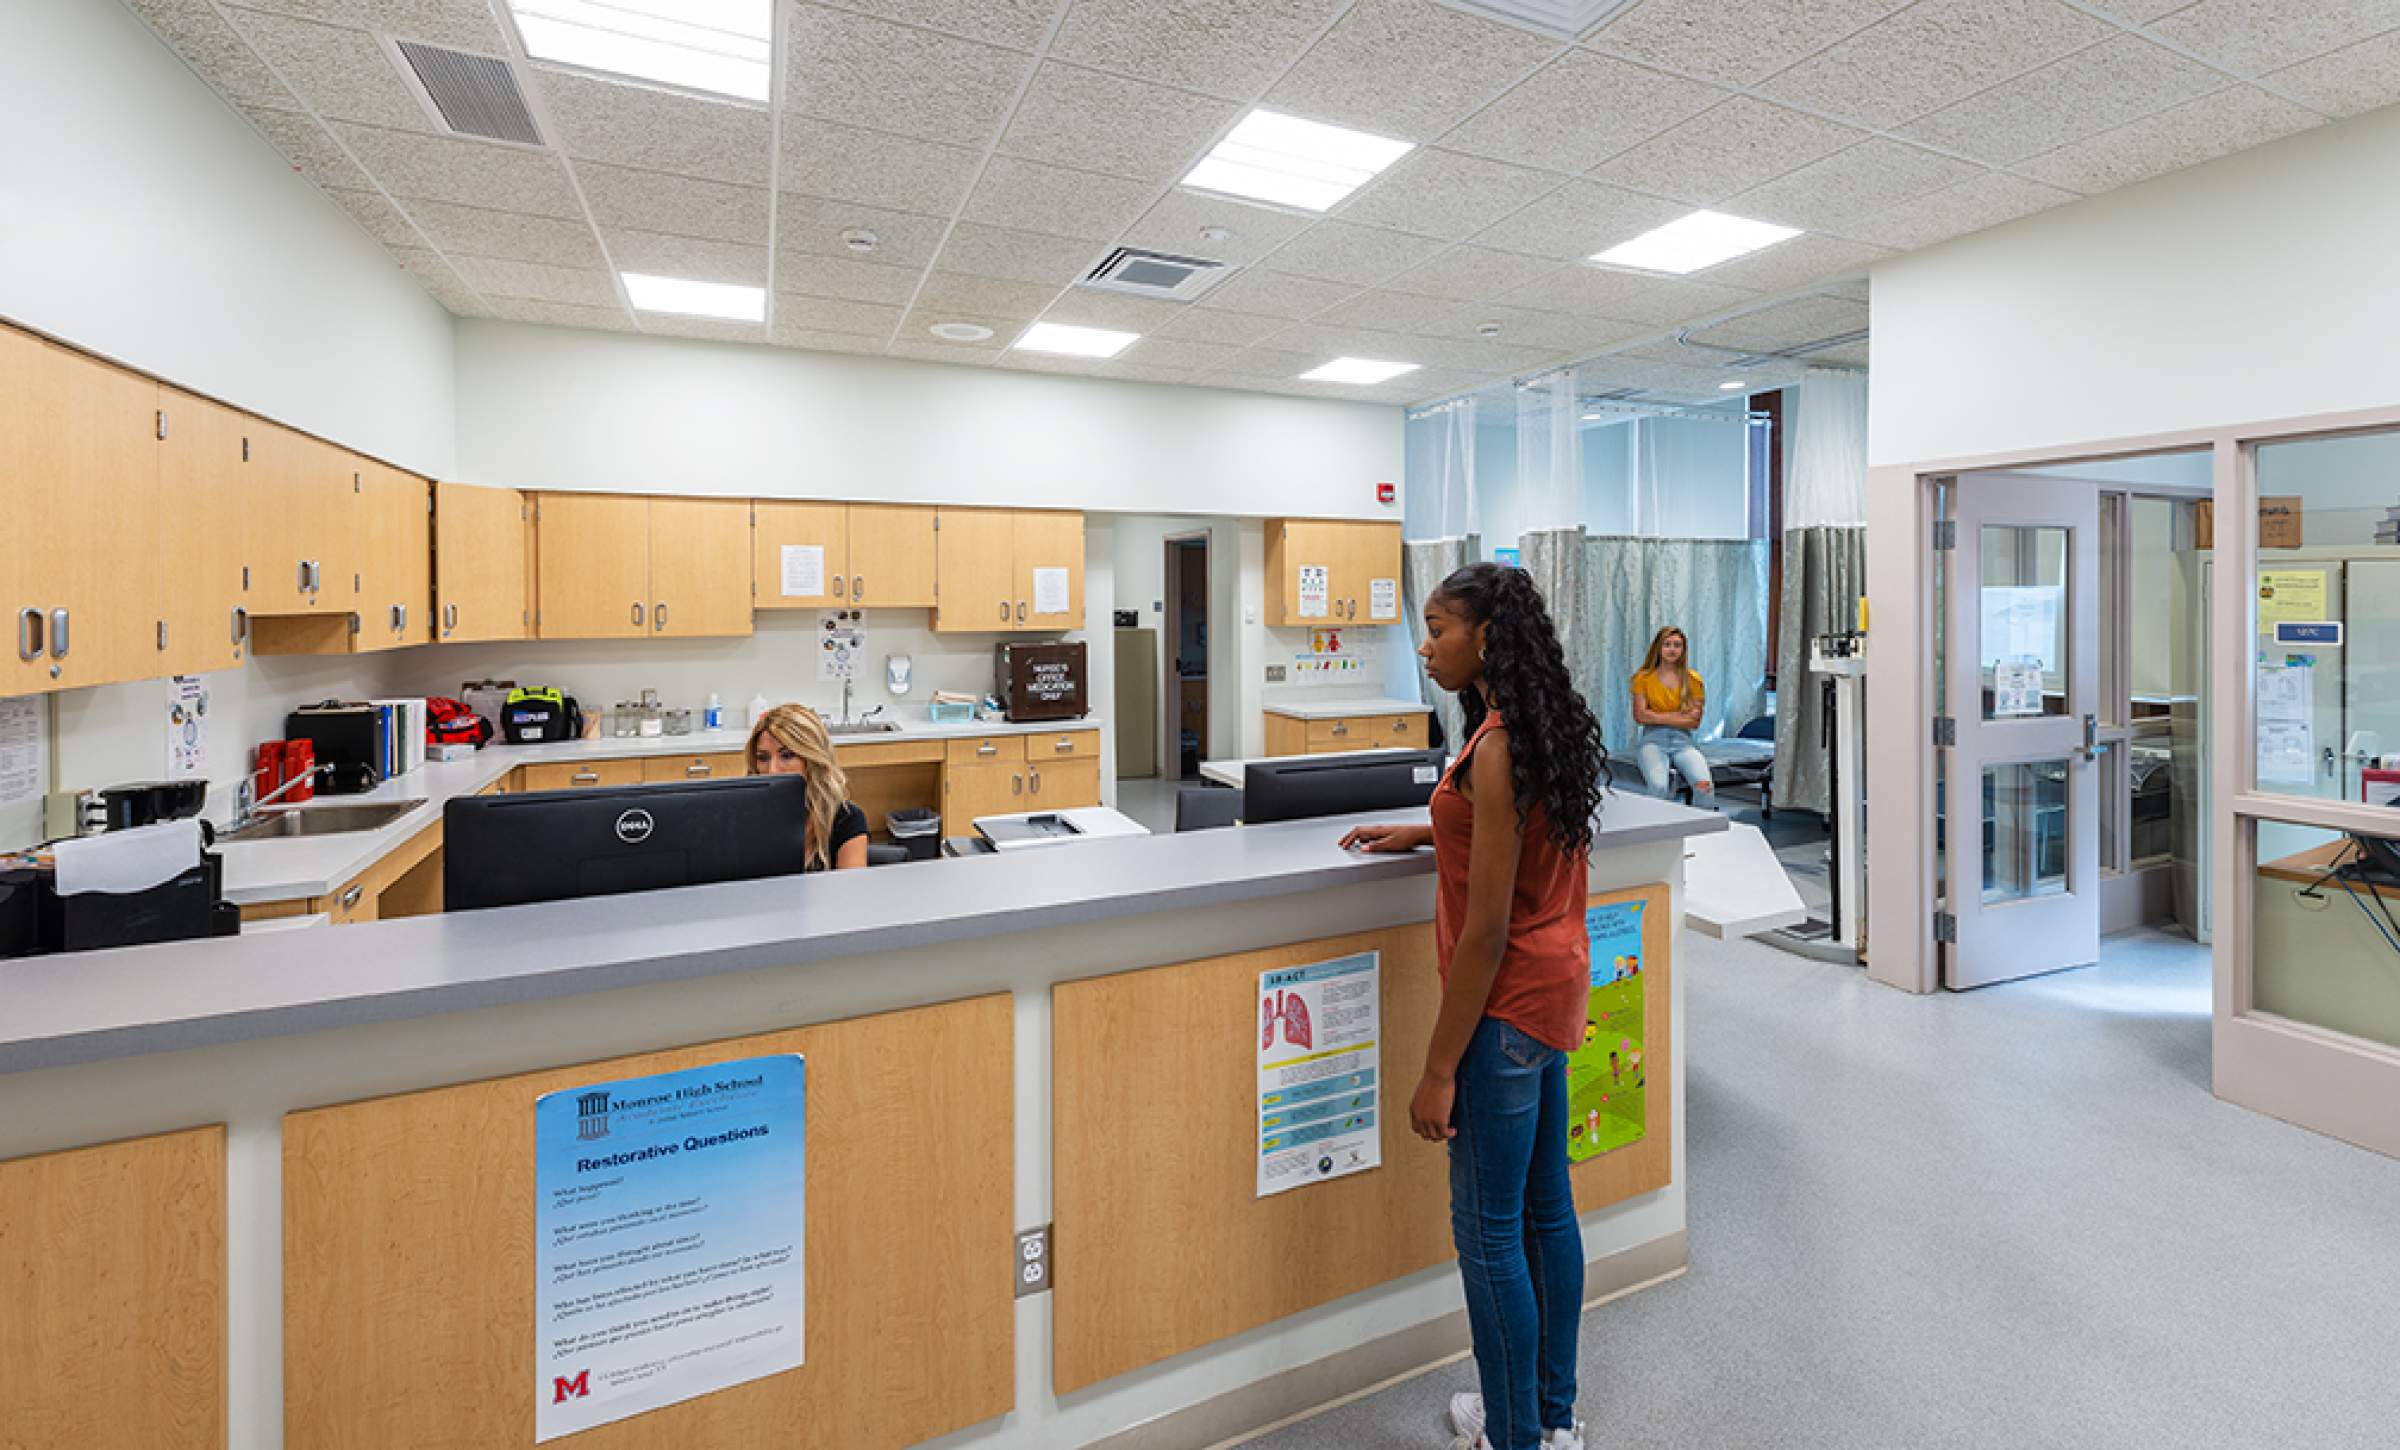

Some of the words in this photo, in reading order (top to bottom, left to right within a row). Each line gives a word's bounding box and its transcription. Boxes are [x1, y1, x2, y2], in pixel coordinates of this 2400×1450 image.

[611, 1092, 673, 1112] Monroe
[674, 1083, 713, 1102] High
[713, 1074, 764, 1094] School
[577, 1143, 680, 1173] Restorative
[683, 1124, 770, 1152] Questions
[552, 1368, 590, 1405] M
